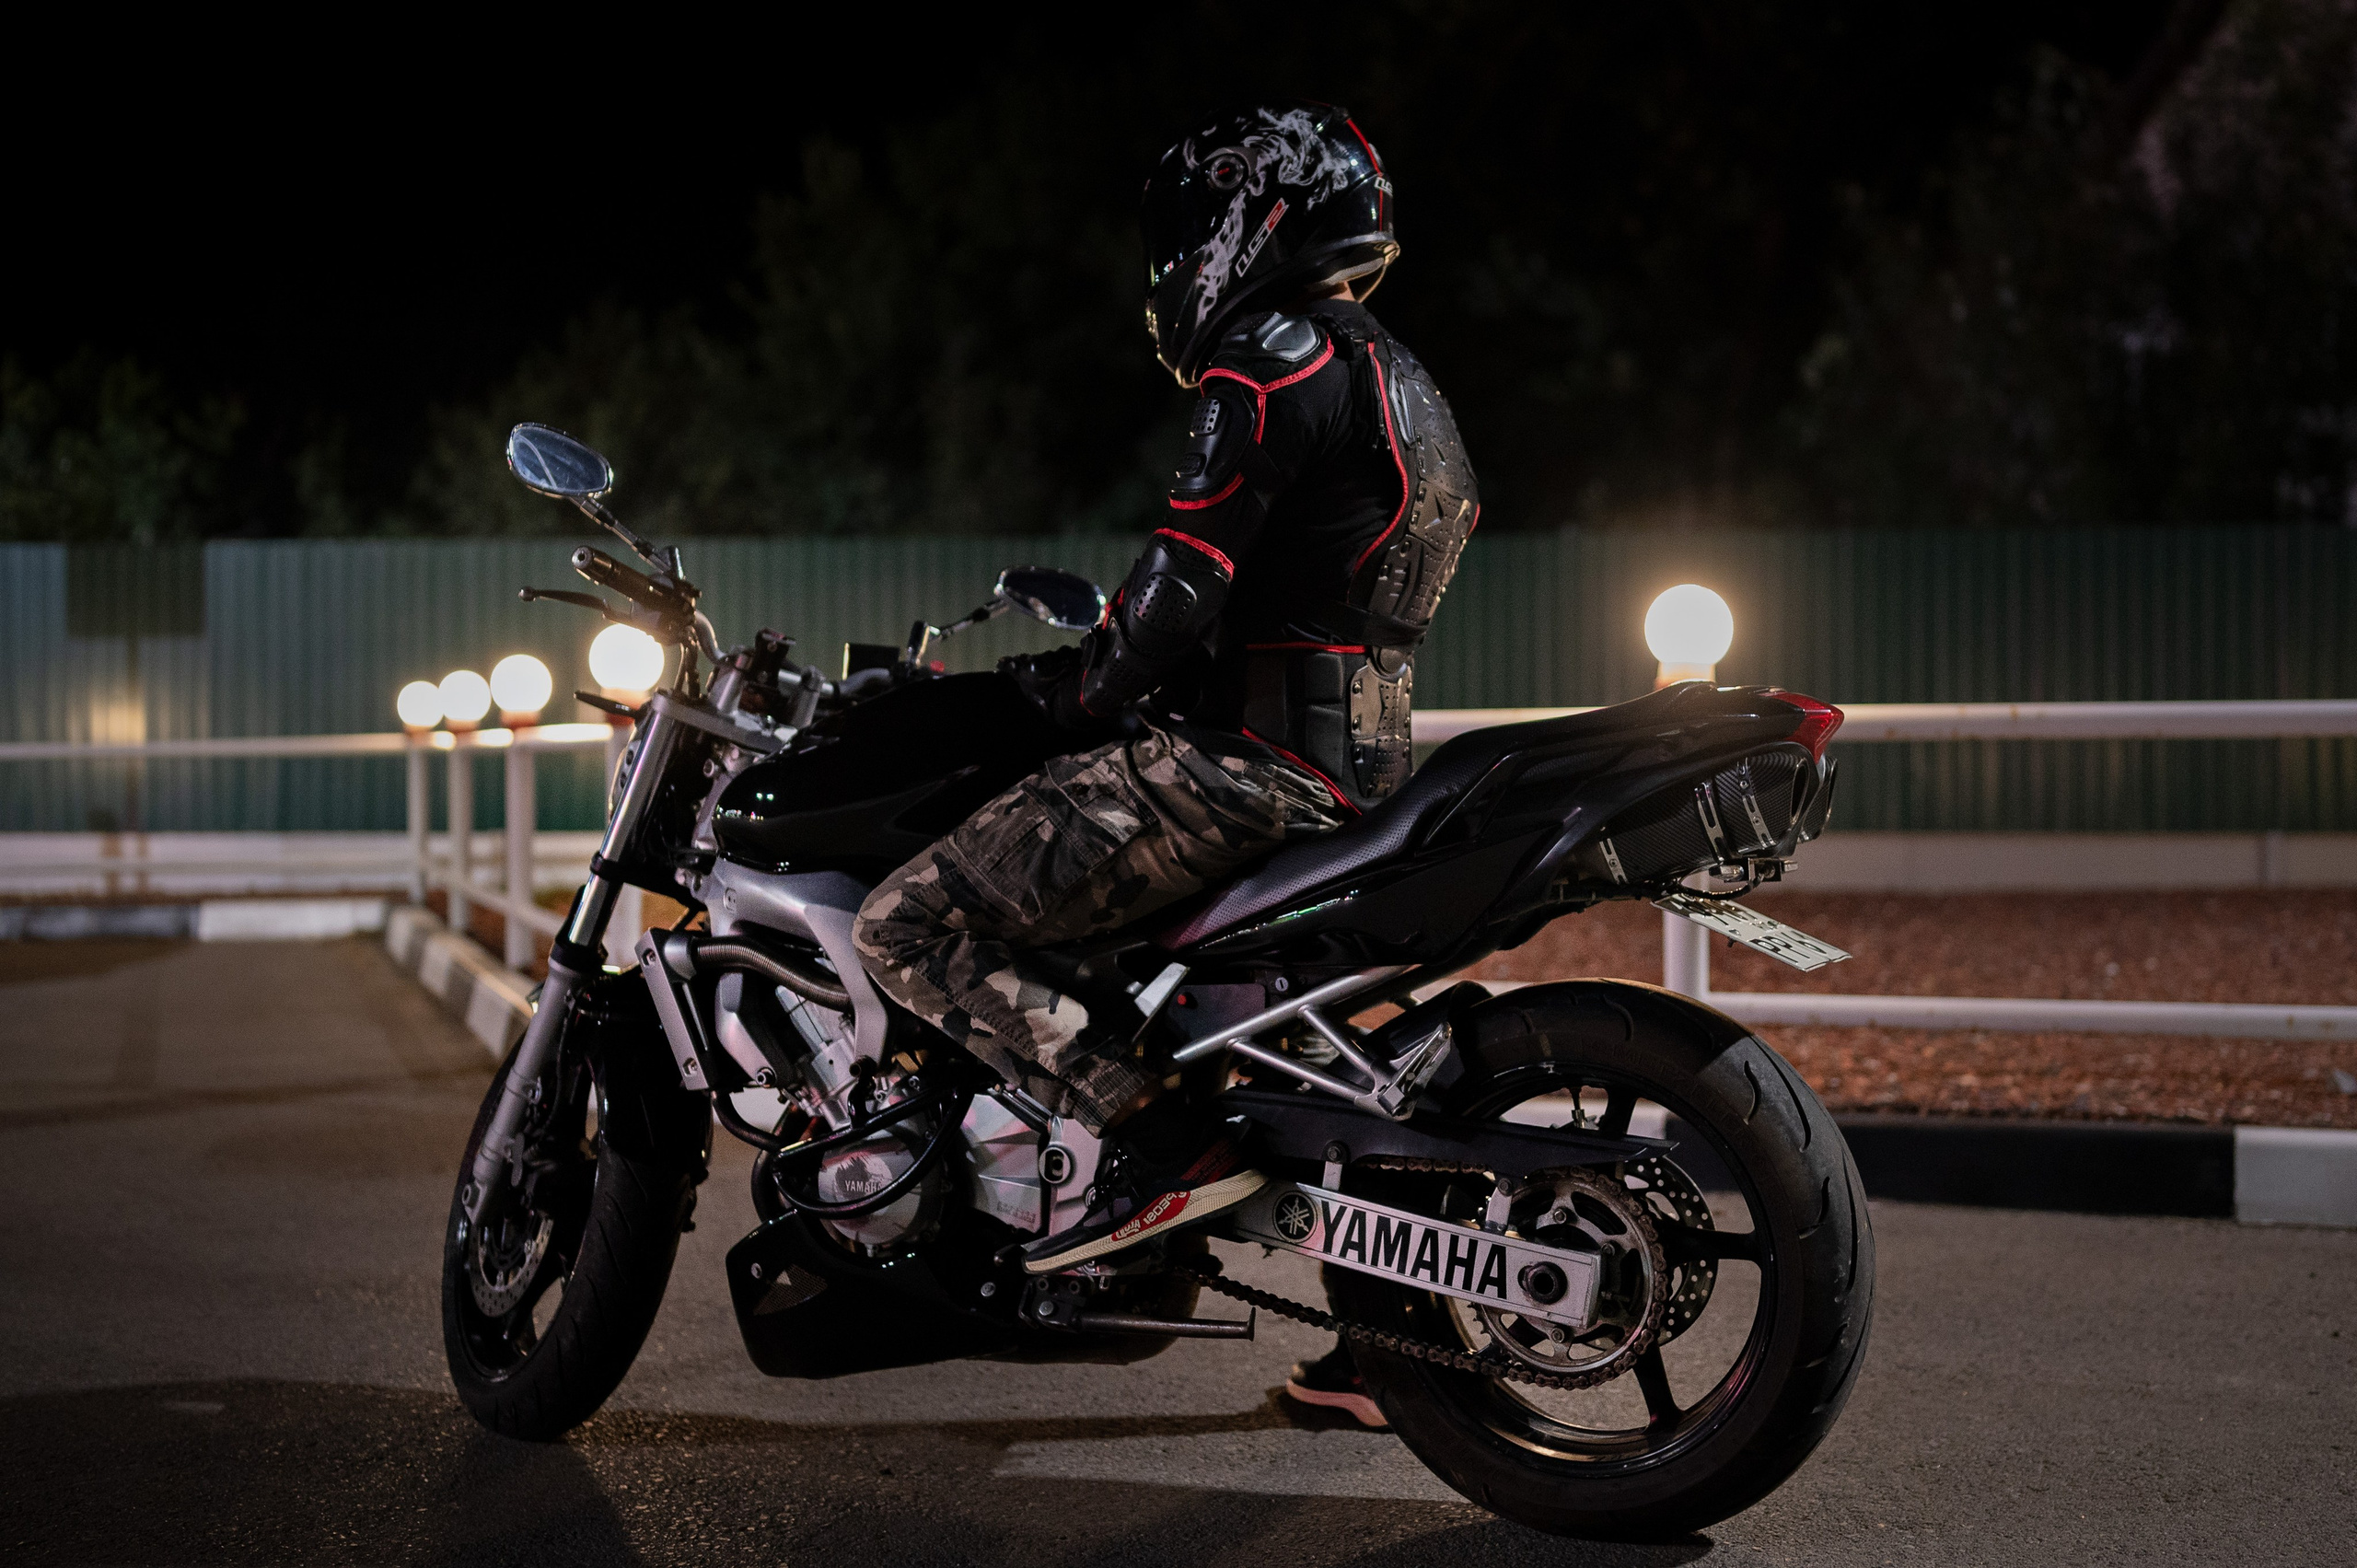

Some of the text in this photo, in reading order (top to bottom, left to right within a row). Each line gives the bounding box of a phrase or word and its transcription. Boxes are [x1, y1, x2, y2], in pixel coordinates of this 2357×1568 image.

[1235, 197, 1290, 278] LS2
[844, 1179, 881, 1193] YAMAHA
[1321, 1200, 1507, 1300] YAMAHA
